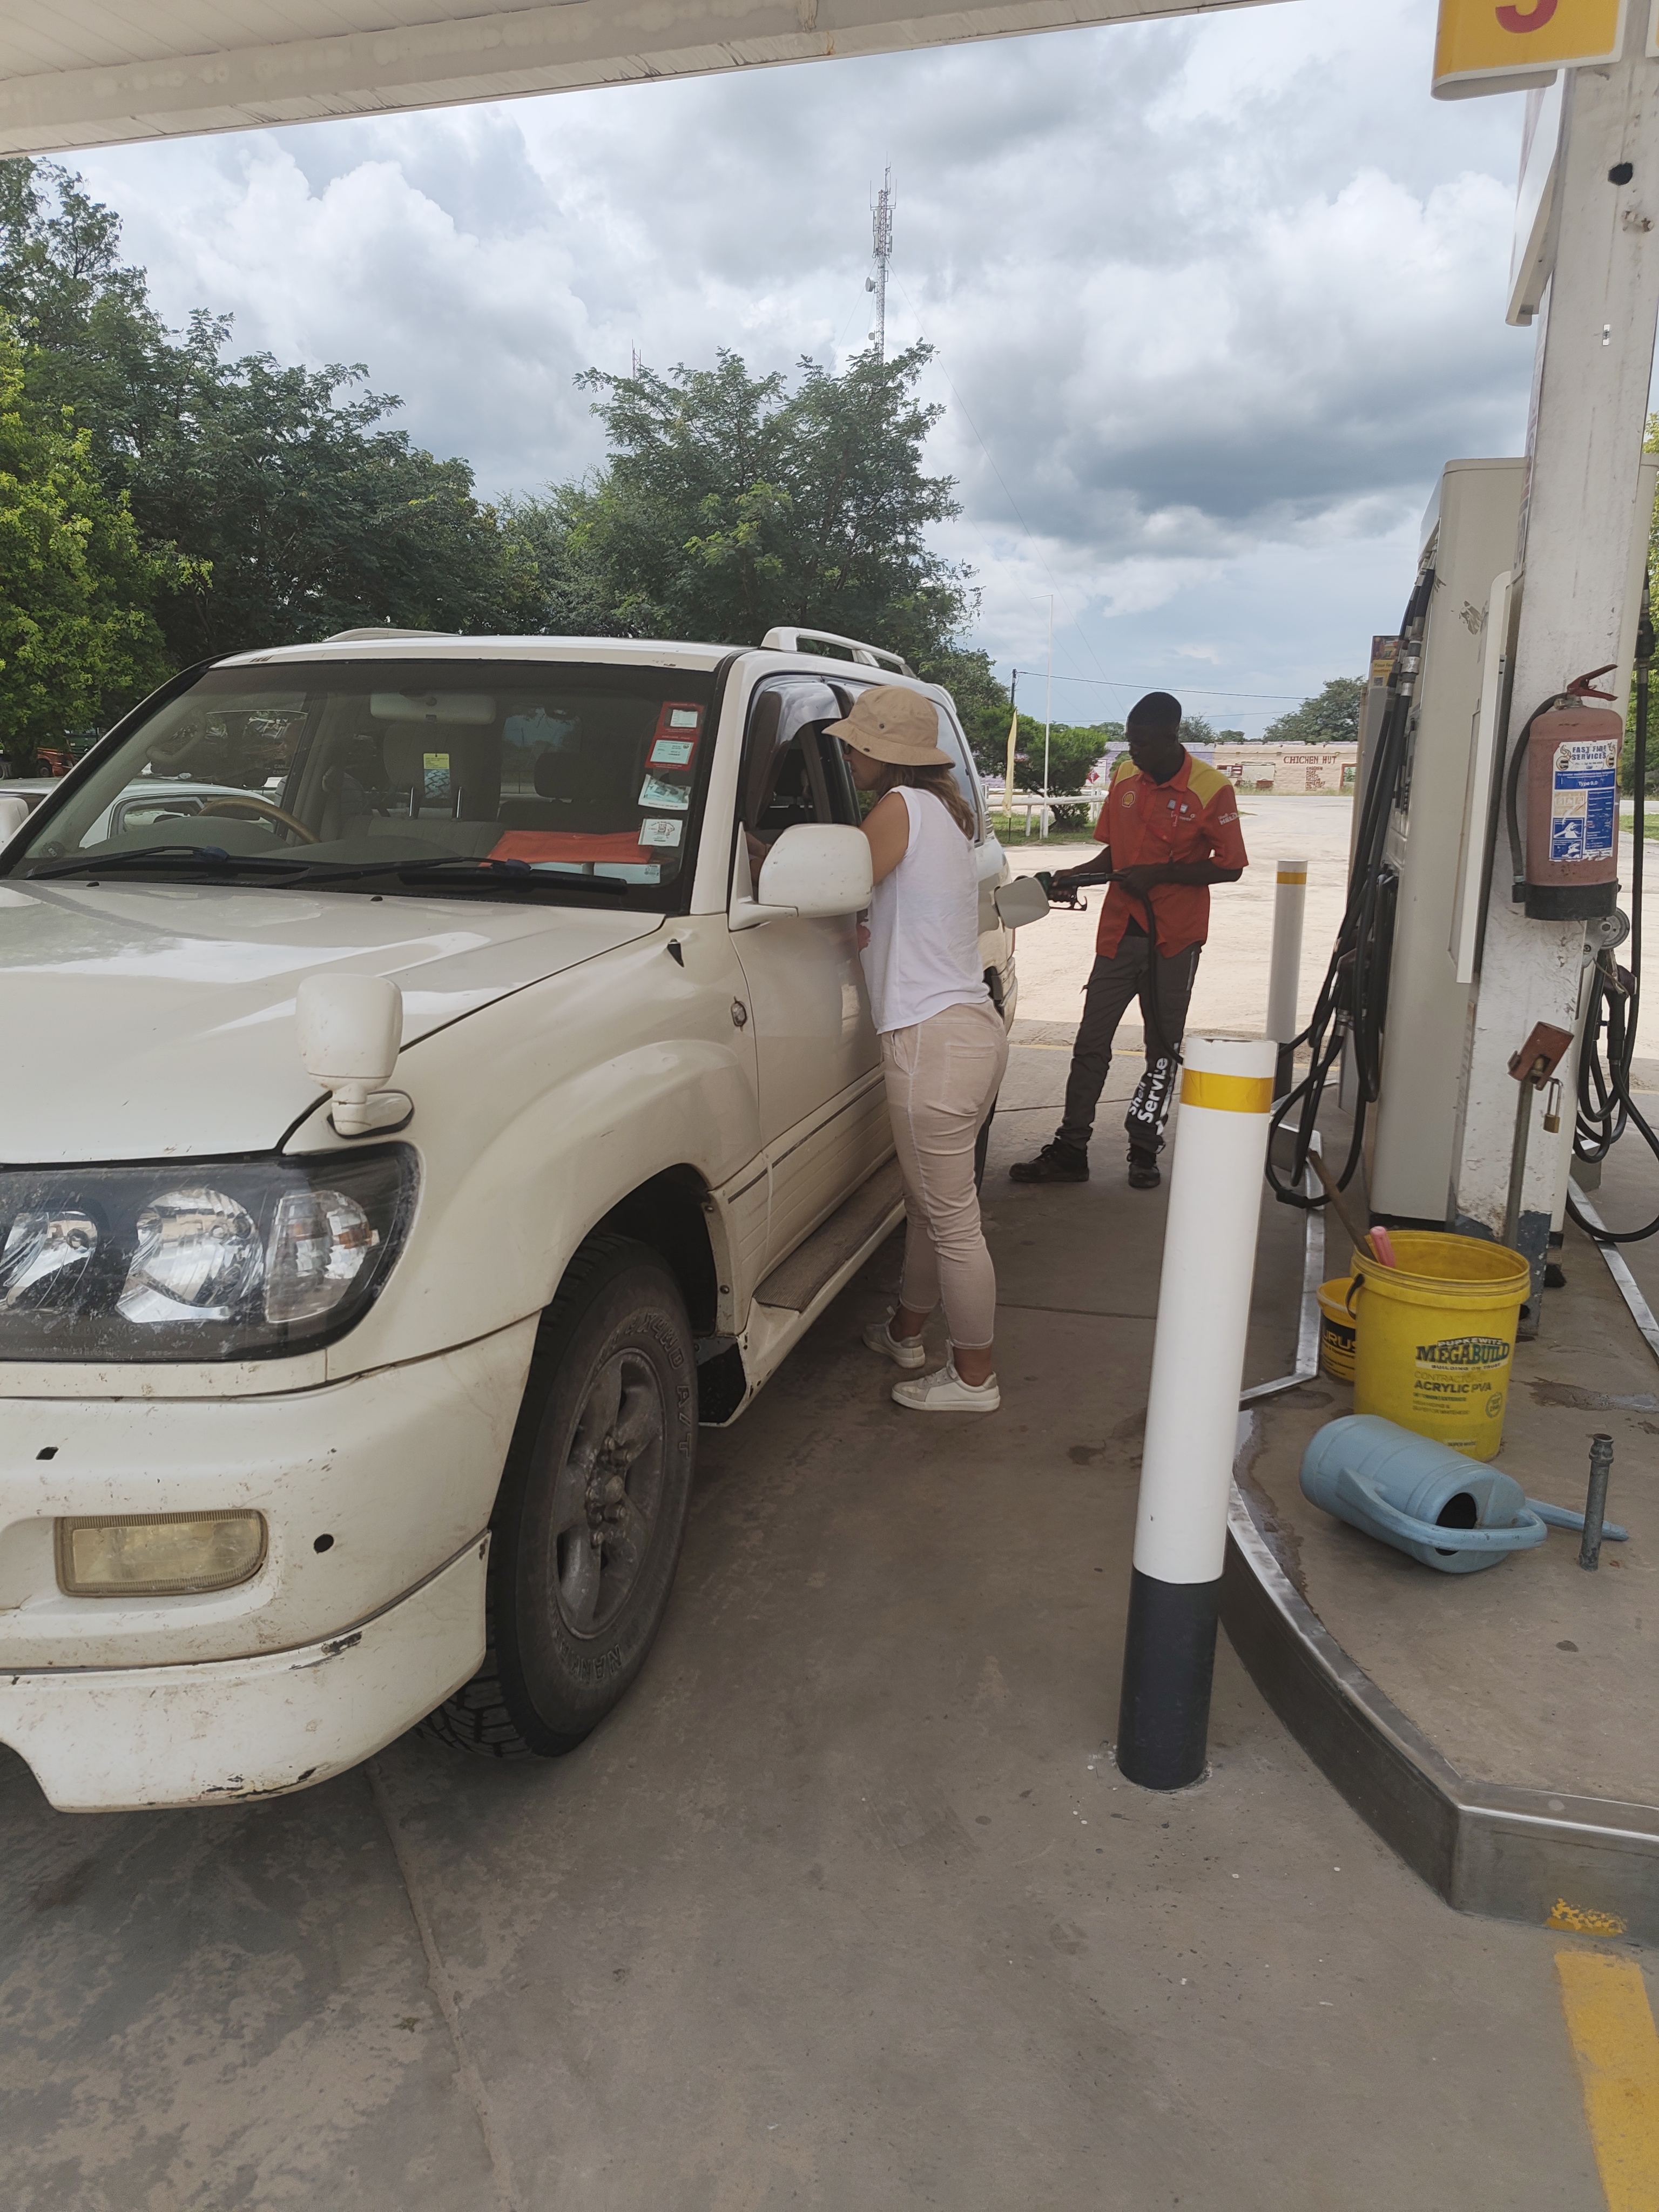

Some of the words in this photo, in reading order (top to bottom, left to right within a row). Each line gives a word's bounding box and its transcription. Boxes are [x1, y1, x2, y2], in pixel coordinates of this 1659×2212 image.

[1438, 1337, 1503, 1347] PUPKEWITZ
[1415, 1343, 1509, 1365] MEGABUILD
[1414, 1380, 1470, 1394] ACRYLIC
[1471, 1382, 1492, 1393] PVA
